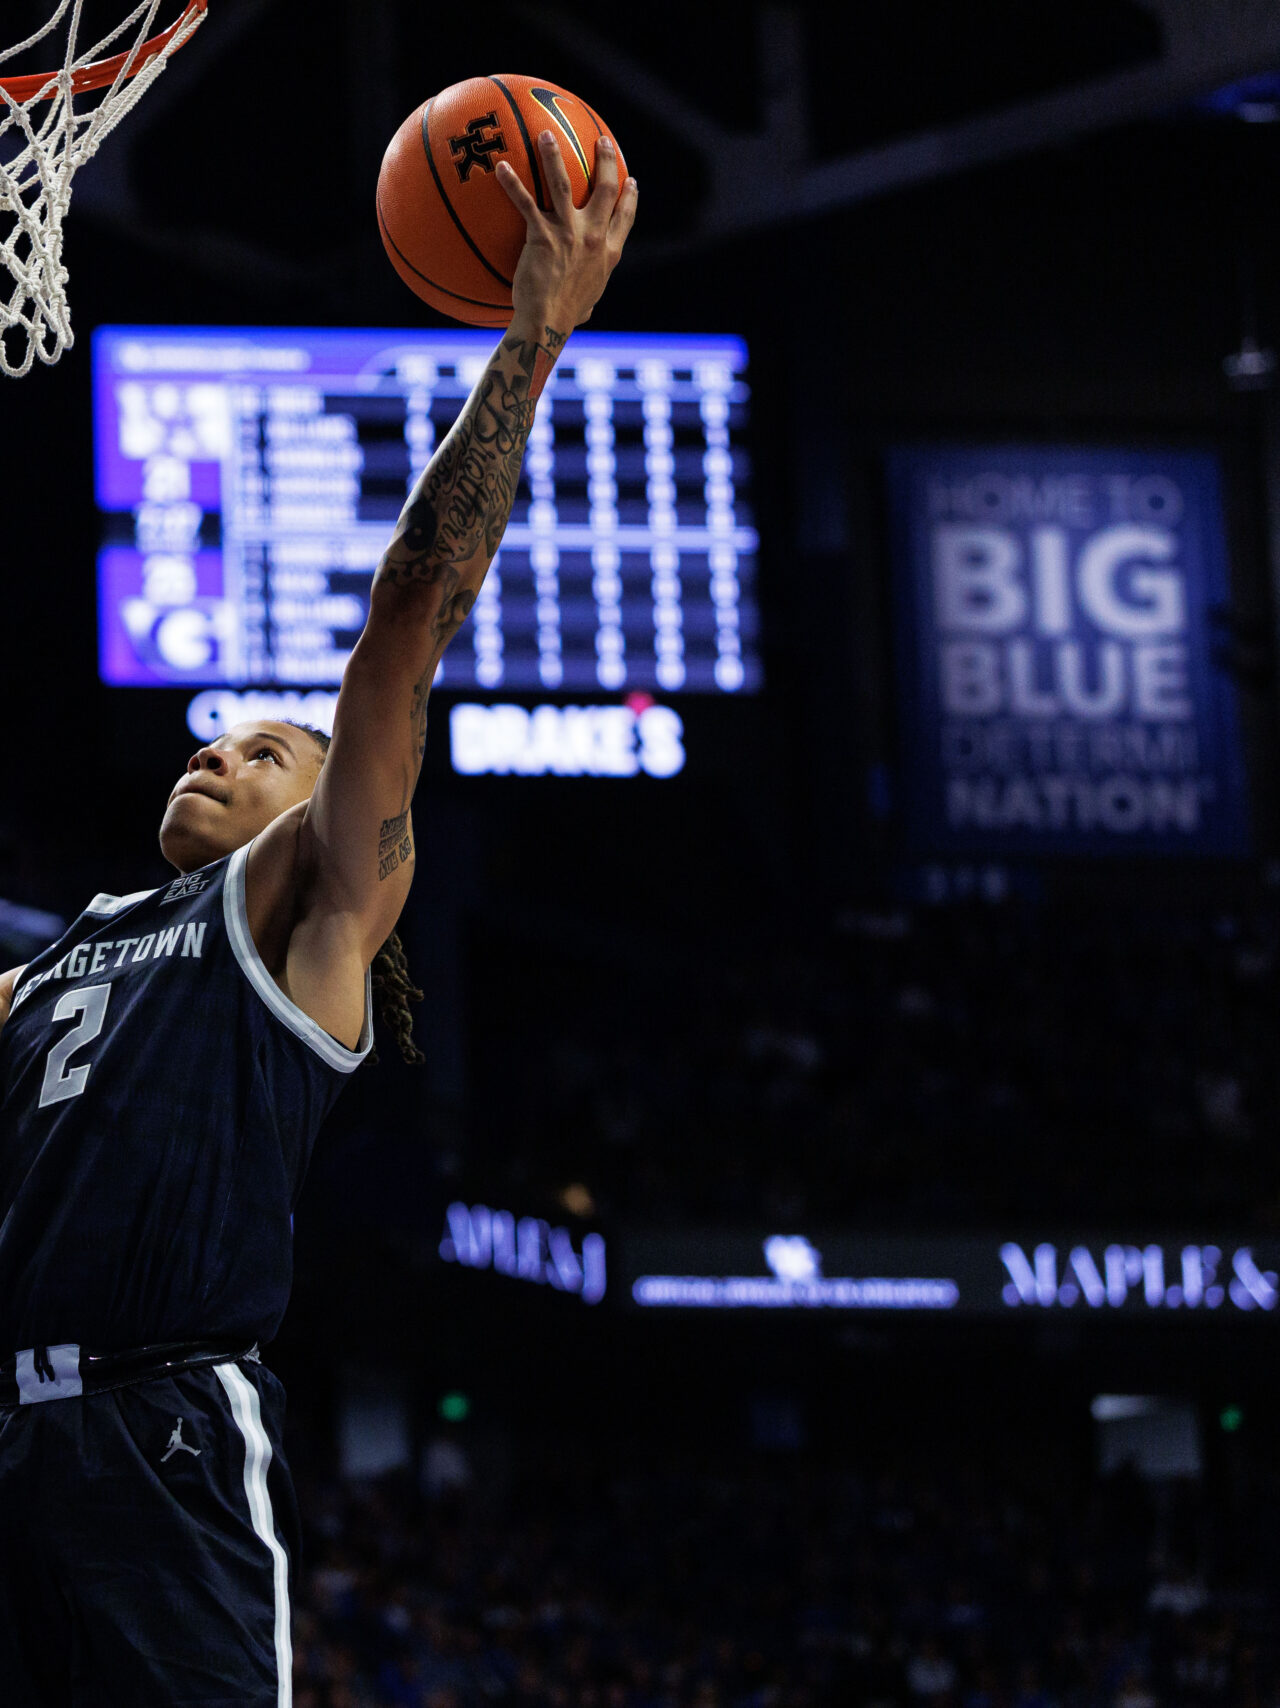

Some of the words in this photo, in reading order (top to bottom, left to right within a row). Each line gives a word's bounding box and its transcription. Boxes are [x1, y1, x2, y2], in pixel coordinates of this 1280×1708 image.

[928, 472, 1092, 528] HOME
[1108, 474, 1183, 528] TO
[933, 523, 1185, 637] BIG
[942, 636, 1192, 720] BLUE
[163, 880, 210, 900] EAST
[170, 873, 204, 889] BIG
[38, 982, 112, 1109] 2
